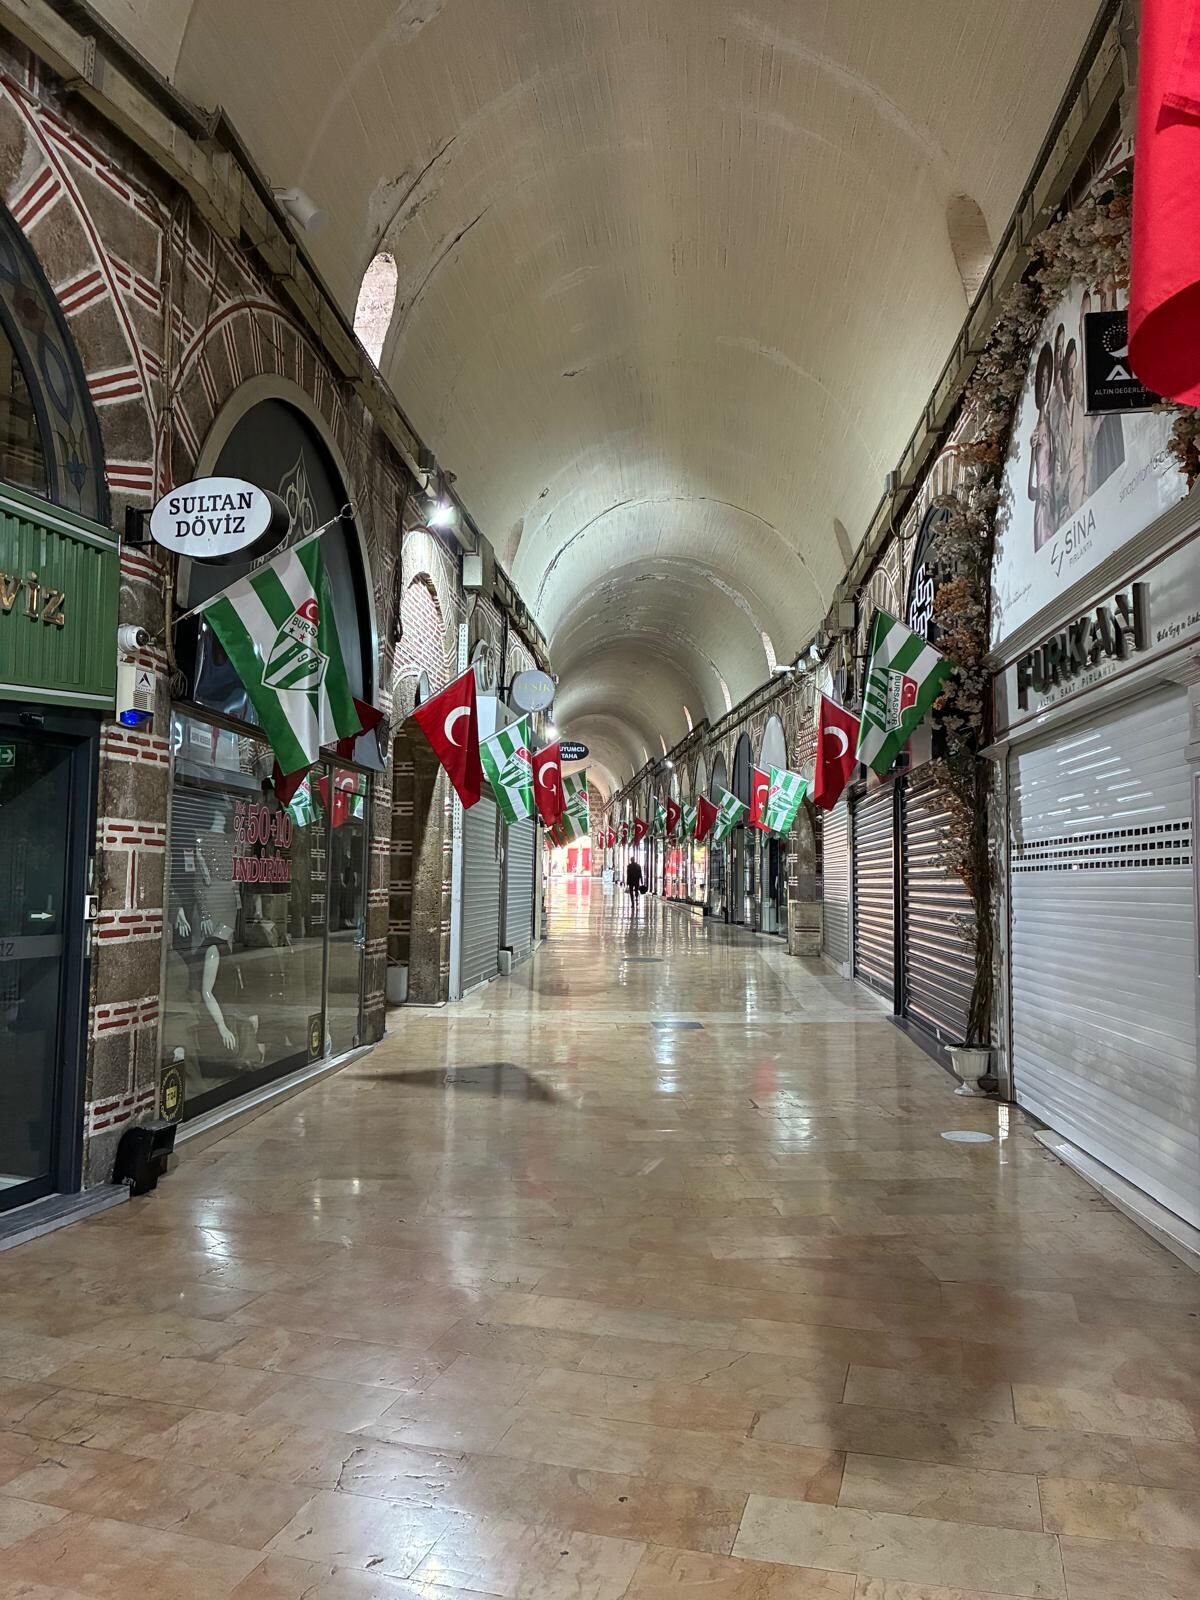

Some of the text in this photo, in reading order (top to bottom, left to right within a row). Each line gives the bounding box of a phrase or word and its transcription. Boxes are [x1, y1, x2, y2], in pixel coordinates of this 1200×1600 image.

[1094, 388, 1114, 396] ALTIN
[169, 492, 254, 515] SULTAN
[175, 514, 246, 538] DÖVİZ
[1064, 508, 1096, 555] SİNA
[890, 675, 902, 726] BURSASPOR
[1060, 682, 1076, 698] SAAT
[231, 844, 293, 883] İNDİRİM
